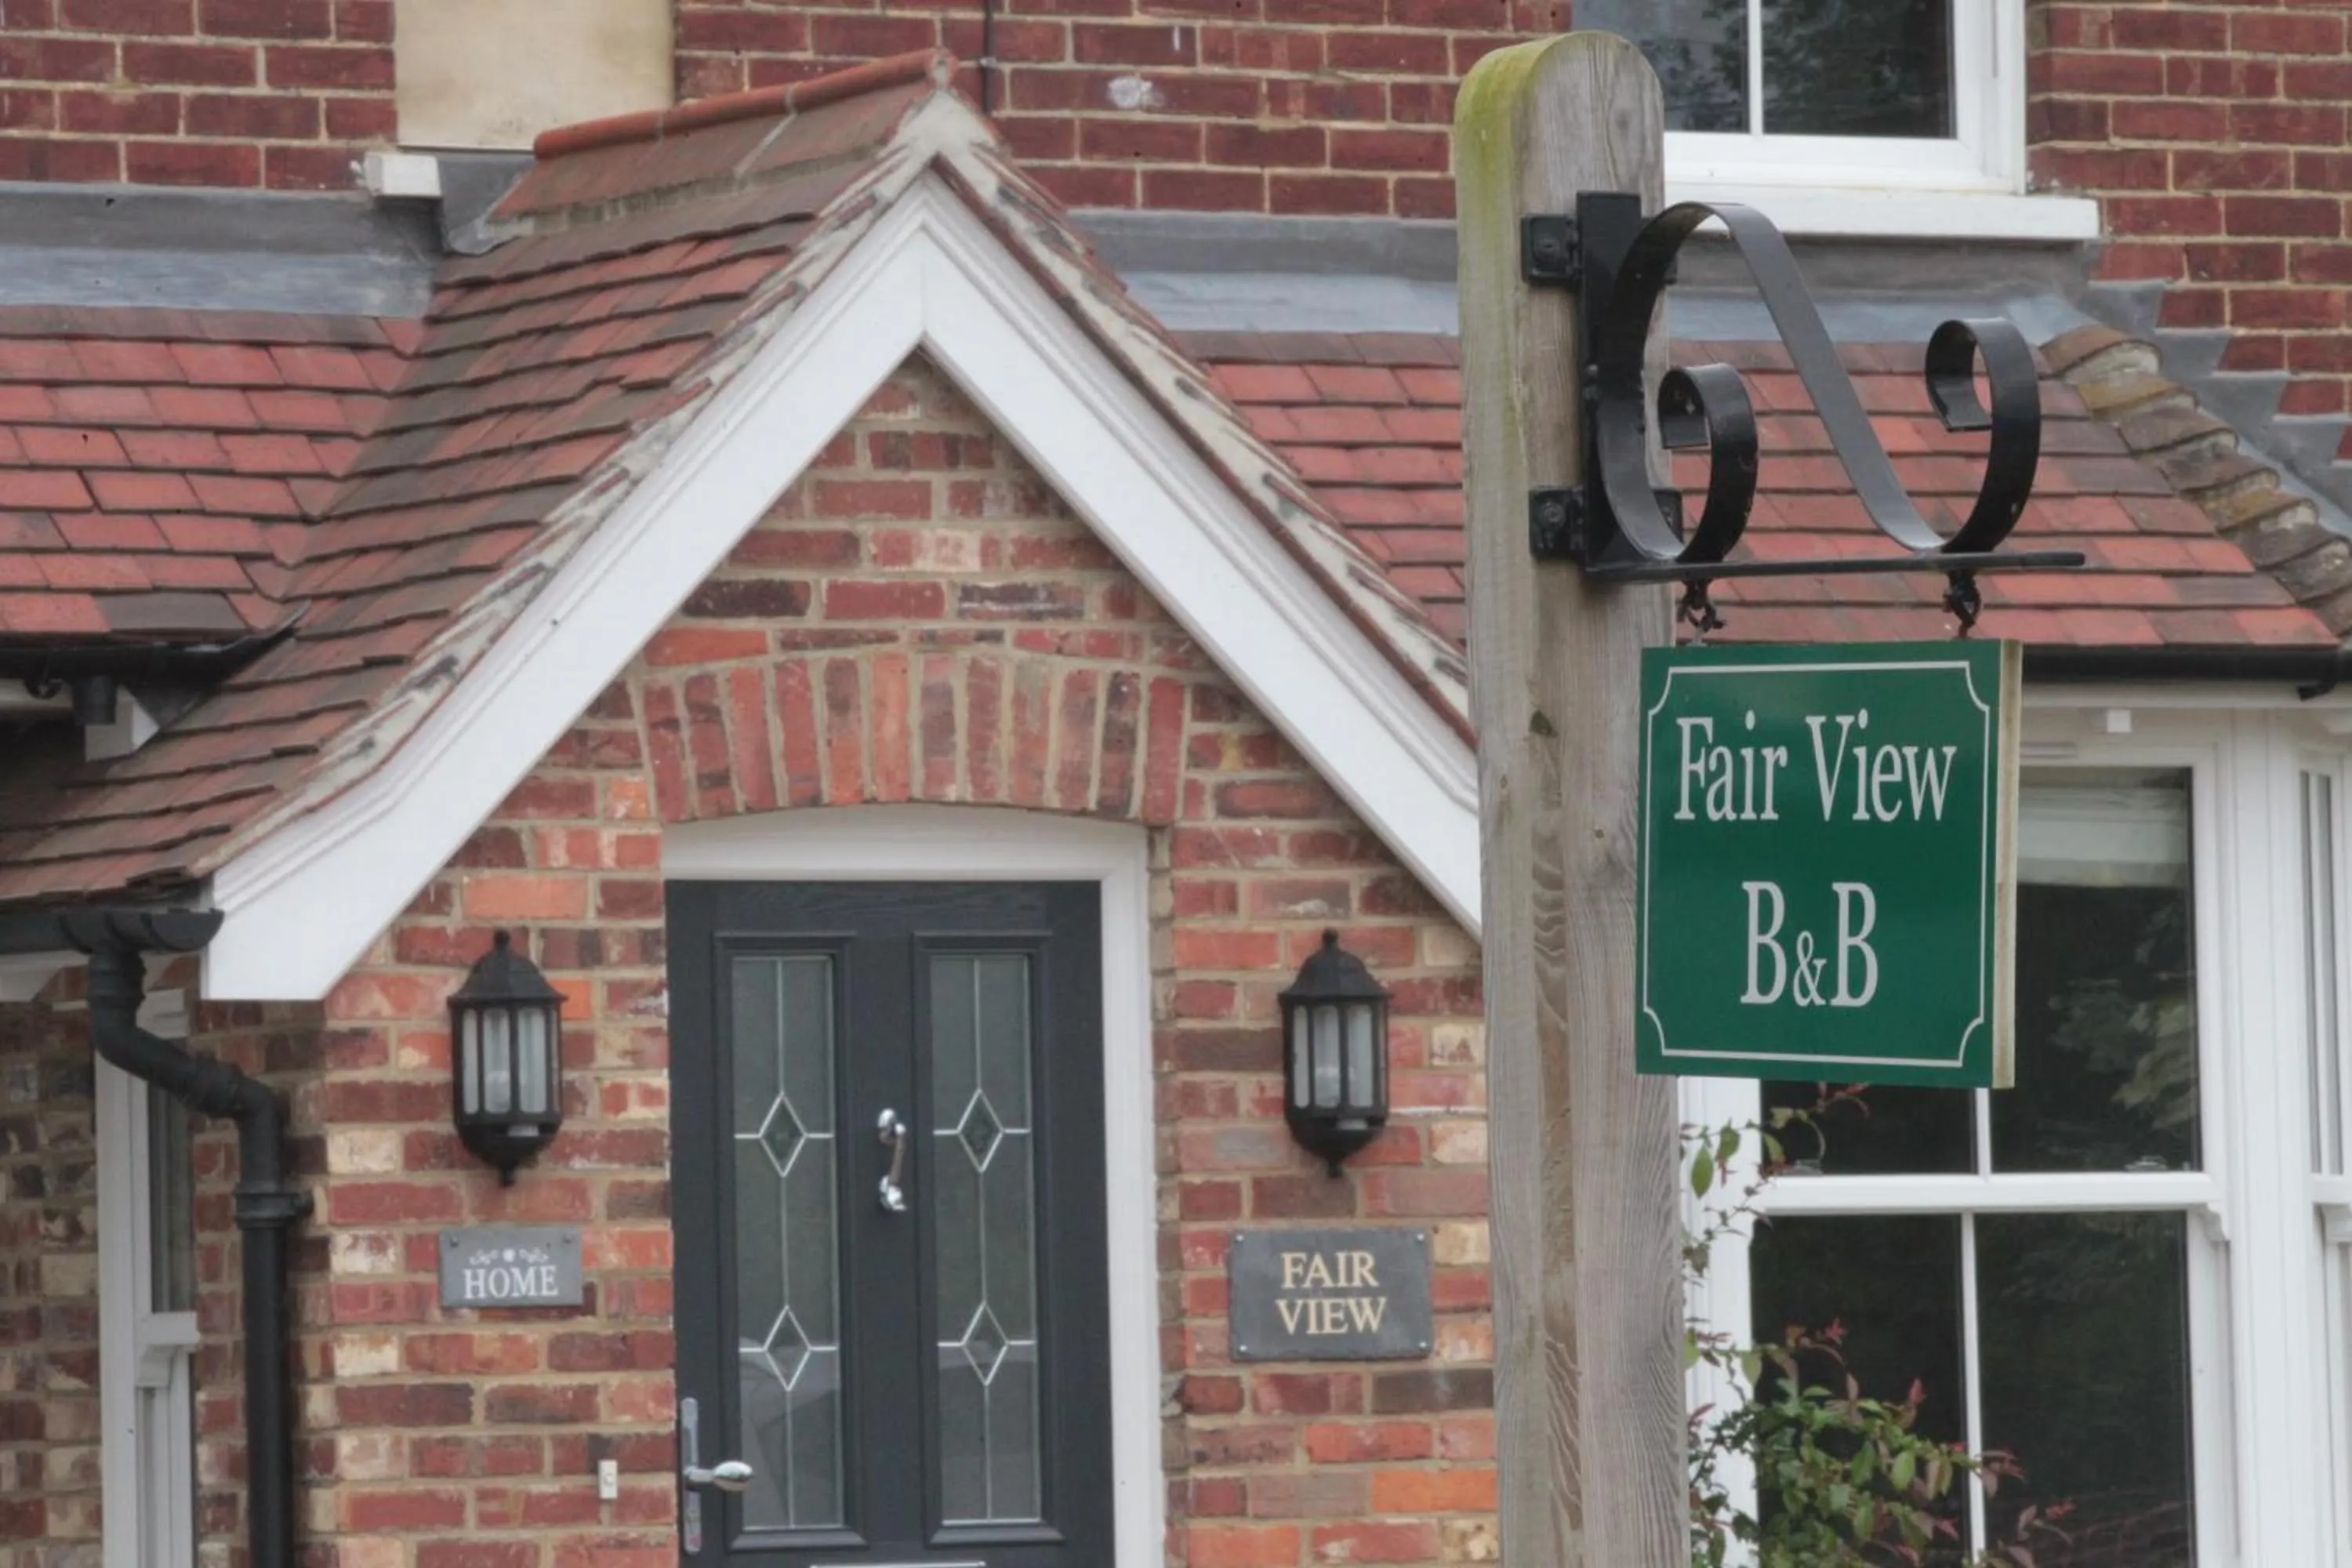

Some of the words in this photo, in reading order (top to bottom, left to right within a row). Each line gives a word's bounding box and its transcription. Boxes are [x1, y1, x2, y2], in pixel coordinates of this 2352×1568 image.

[1674, 710, 1788, 822] Fair
[1806, 708, 1958, 822] View
[1740, 880, 1879, 1007] B&B
[463, 1265, 559, 1299] HOME
[1280, 1250, 1380, 1289] FAIR
[1275, 1296, 1387, 1335] VIEW
